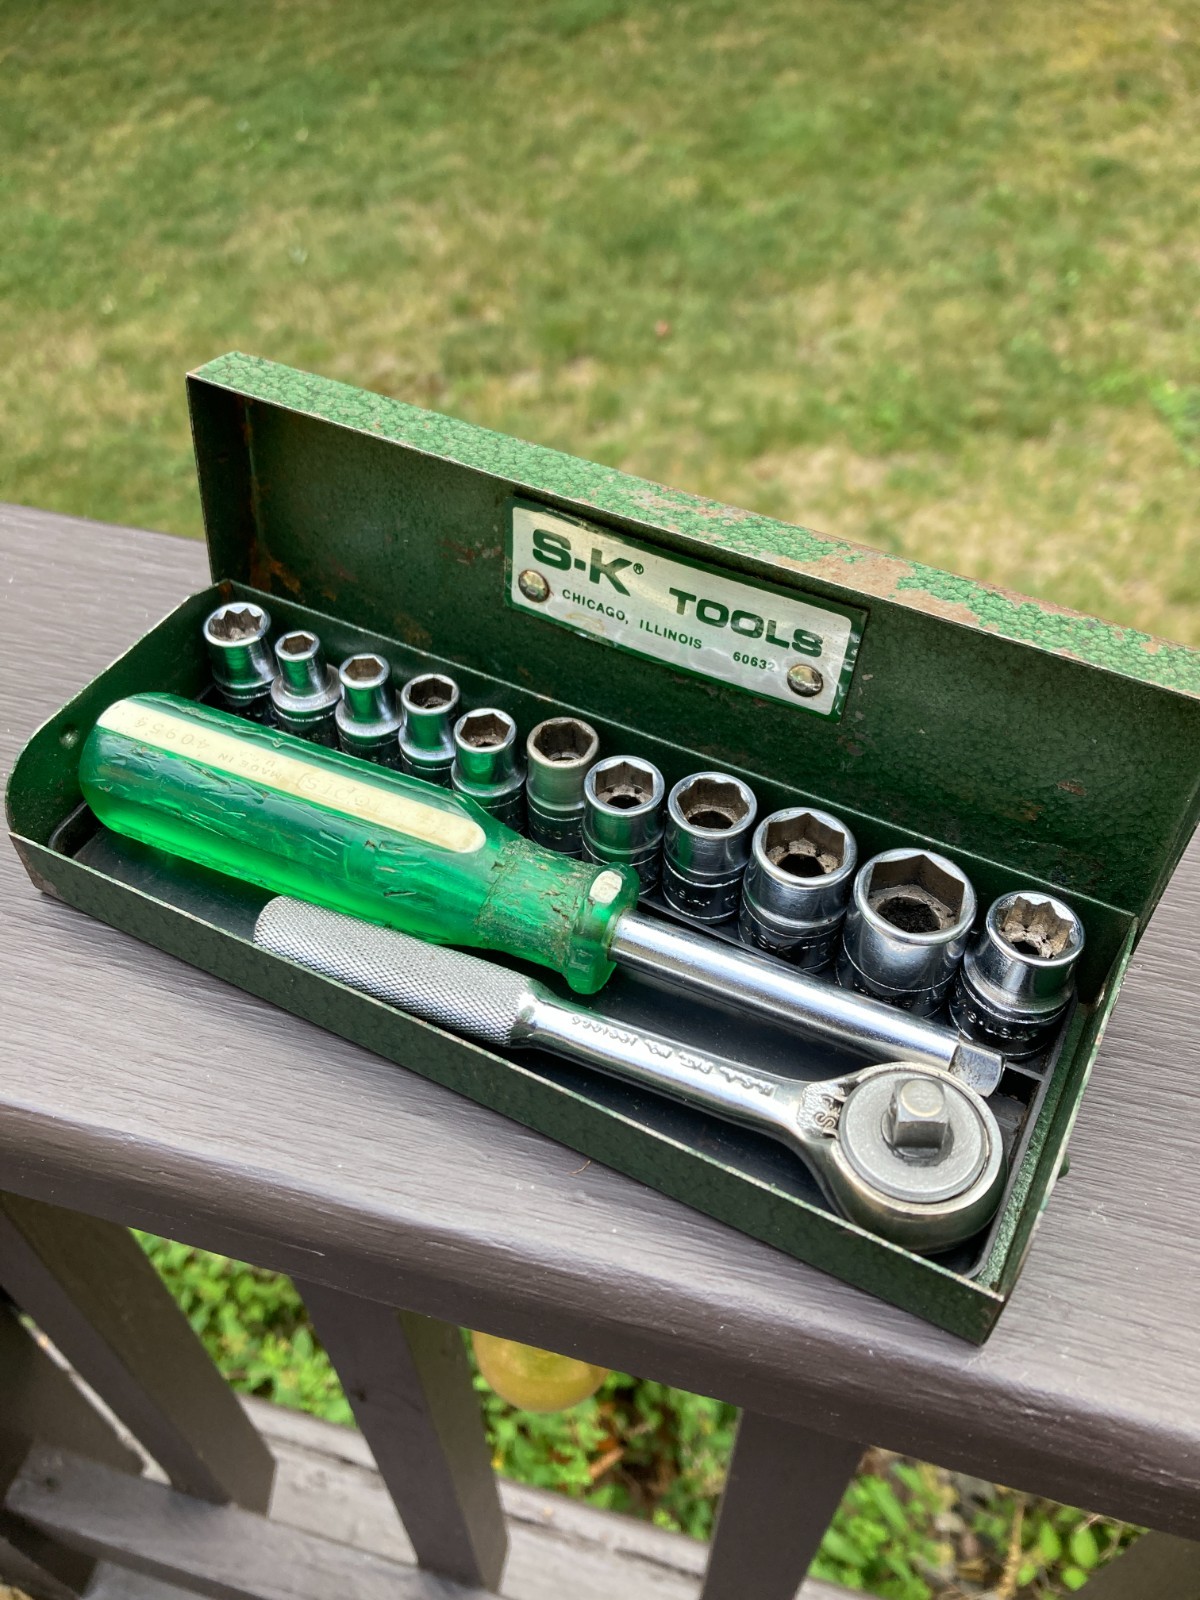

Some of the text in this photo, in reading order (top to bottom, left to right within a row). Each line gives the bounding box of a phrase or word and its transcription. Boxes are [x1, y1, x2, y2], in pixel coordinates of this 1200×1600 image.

[562, 589, 629, 625] CHICAGO,
[640, 619, 703, 650] ILLINOIS
[668, 587, 824, 658] TOOLS
[217, 751, 283, 781] MADE IN
